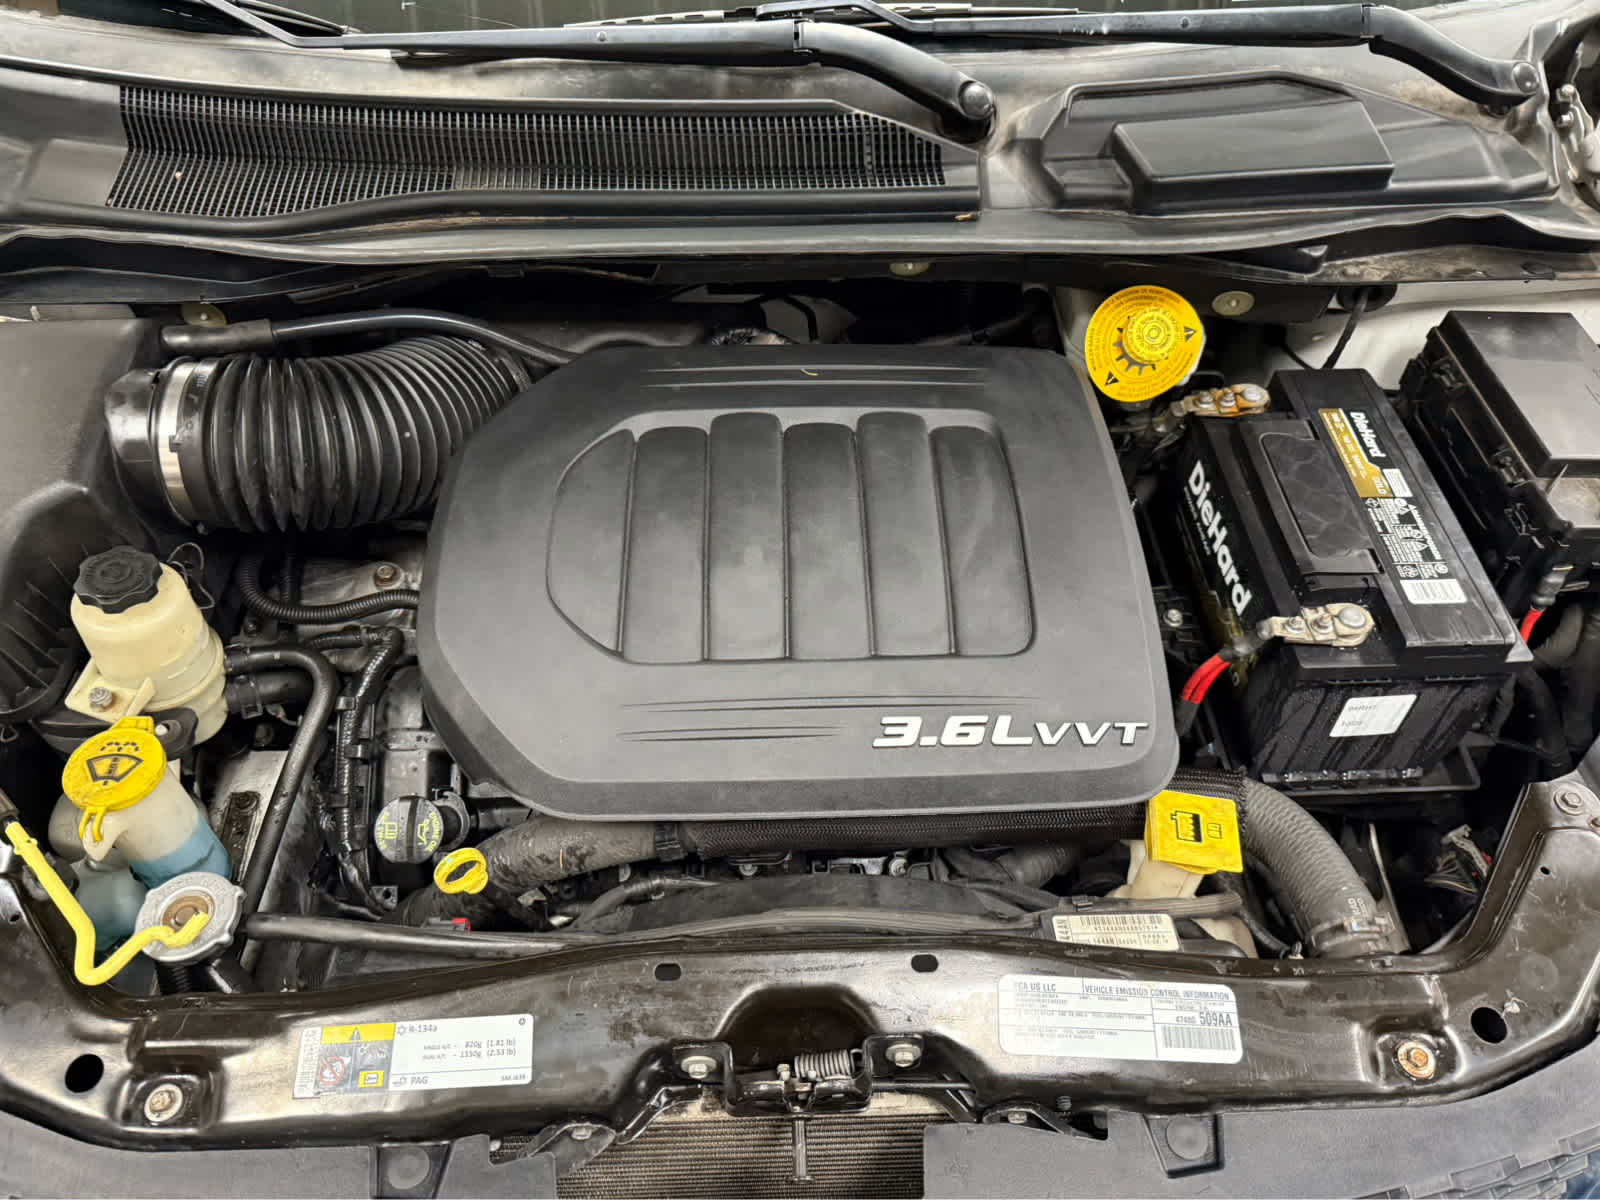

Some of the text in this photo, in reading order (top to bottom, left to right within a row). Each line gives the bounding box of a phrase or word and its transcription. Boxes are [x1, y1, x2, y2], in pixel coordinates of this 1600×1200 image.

[1349, 411, 1387, 457] DieHard
[1188, 459, 1252, 616] DieHard
[1085, 985, 1113, 994] VEHICLE
[1151, 988, 1182, 998] CONTROL
[1183, 990, 1230, 1001] INFORMATION
[1199, 1011, 1233, 1027] 509AA
[408, 1024, 438, 1033] R-134a
[410, 1076, 428, 1086] PAG
